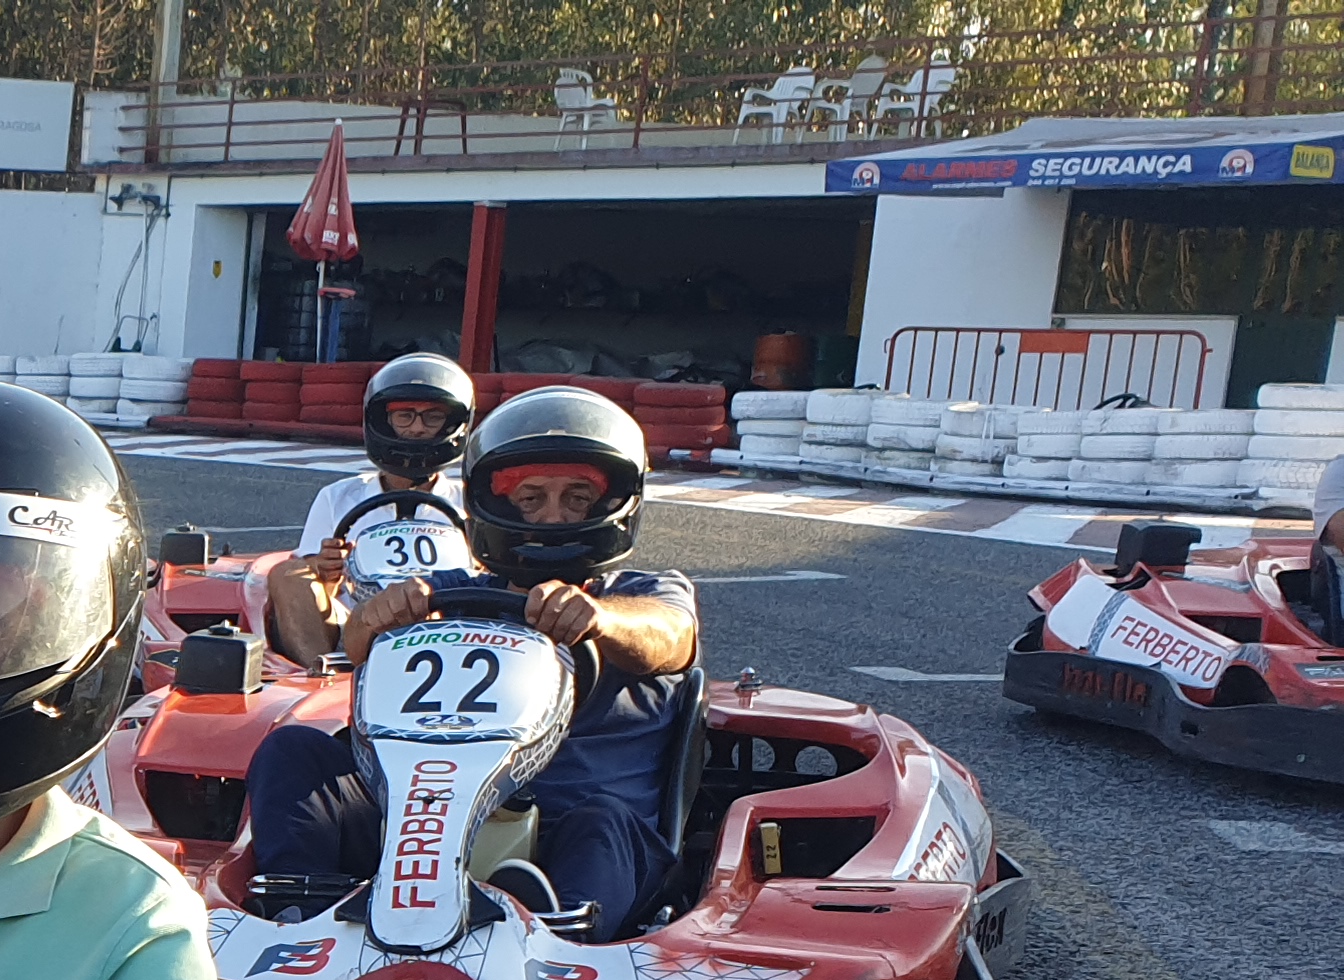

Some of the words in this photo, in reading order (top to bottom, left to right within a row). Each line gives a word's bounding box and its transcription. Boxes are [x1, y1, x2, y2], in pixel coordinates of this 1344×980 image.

[1028, 154, 1193, 178] SEGURANÇA
[369, 527, 447, 540] EUROINDY
[384, 535, 438, 567] 30
[391, 632, 526, 651] EUROINDY
[1110, 615, 1223, 683] FERBERTO
[400, 648, 500, 714] 22
[424, 714, 461, 726] 24
[391, 759, 458, 909] FERBERTO
